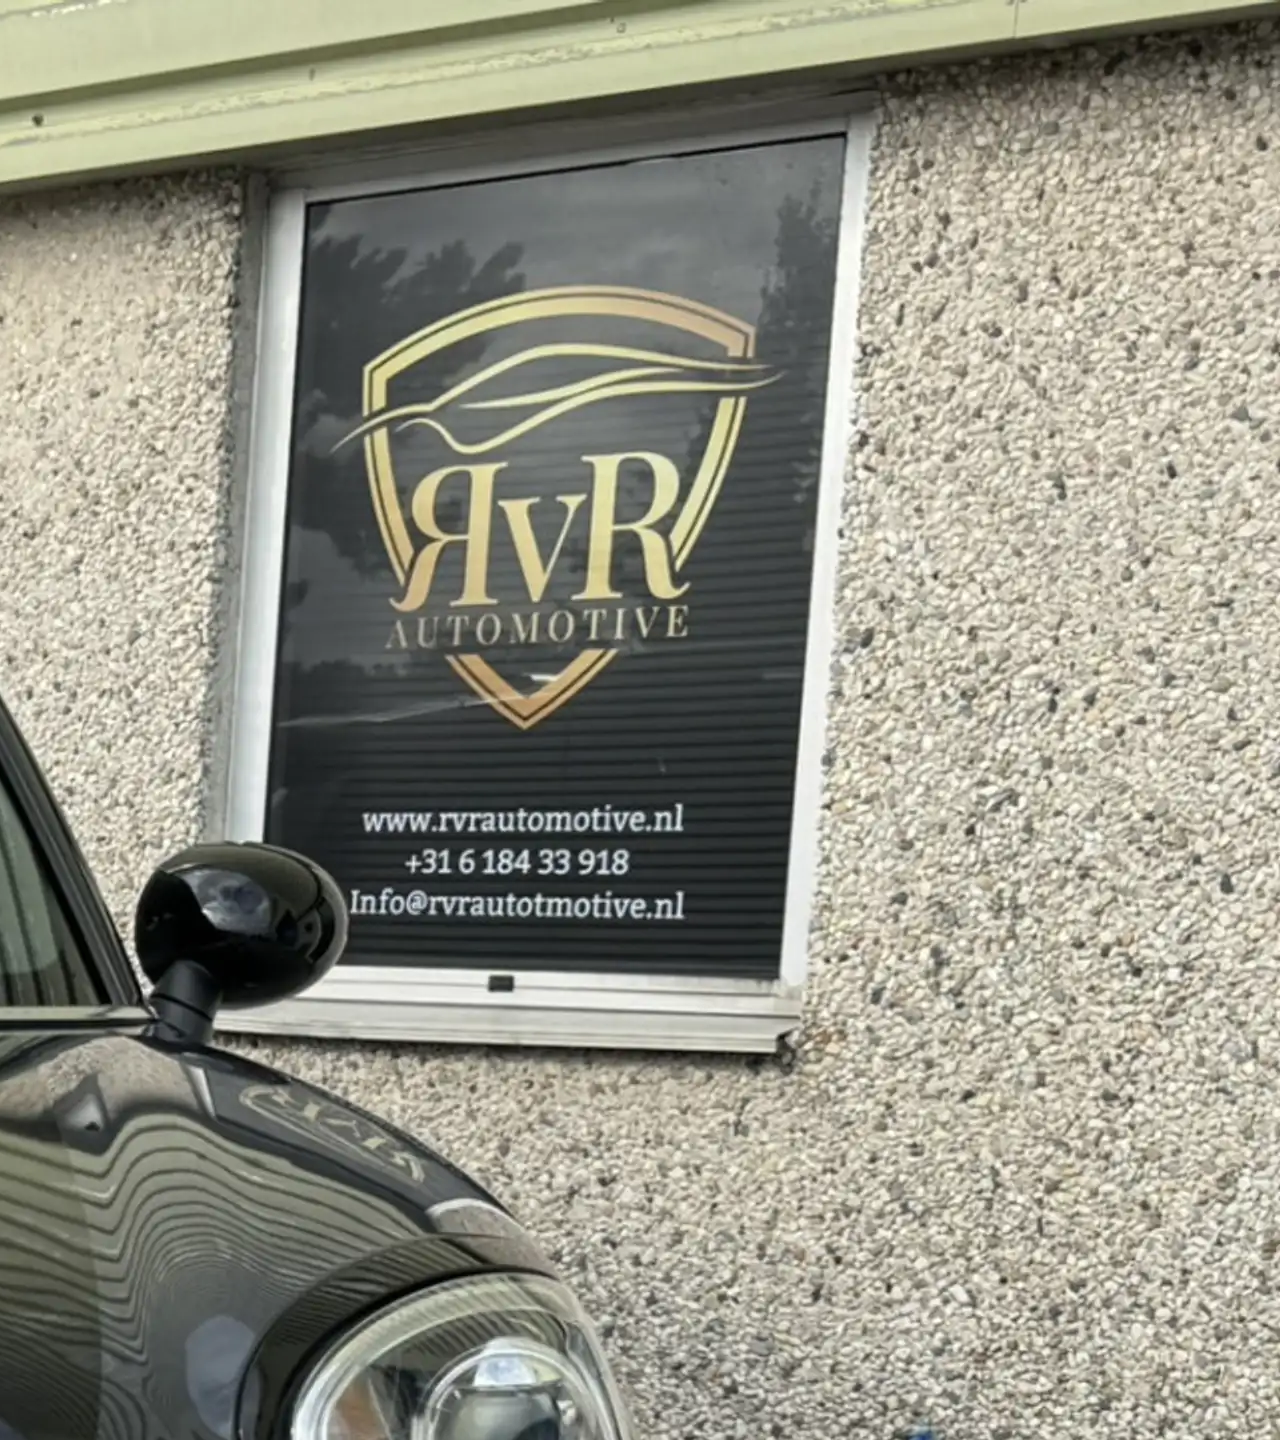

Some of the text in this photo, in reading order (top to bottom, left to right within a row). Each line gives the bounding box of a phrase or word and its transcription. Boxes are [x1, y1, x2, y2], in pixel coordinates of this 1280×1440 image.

[385, 605, 690, 649] AUTOMOTIVE
[362, 803, 684, 833] www.rvrautomotive.nl
[405, 849, 630, 876] +31 6 184 33 918
[350, 888, 686, 919] Info@rvrautotmotive.nl
